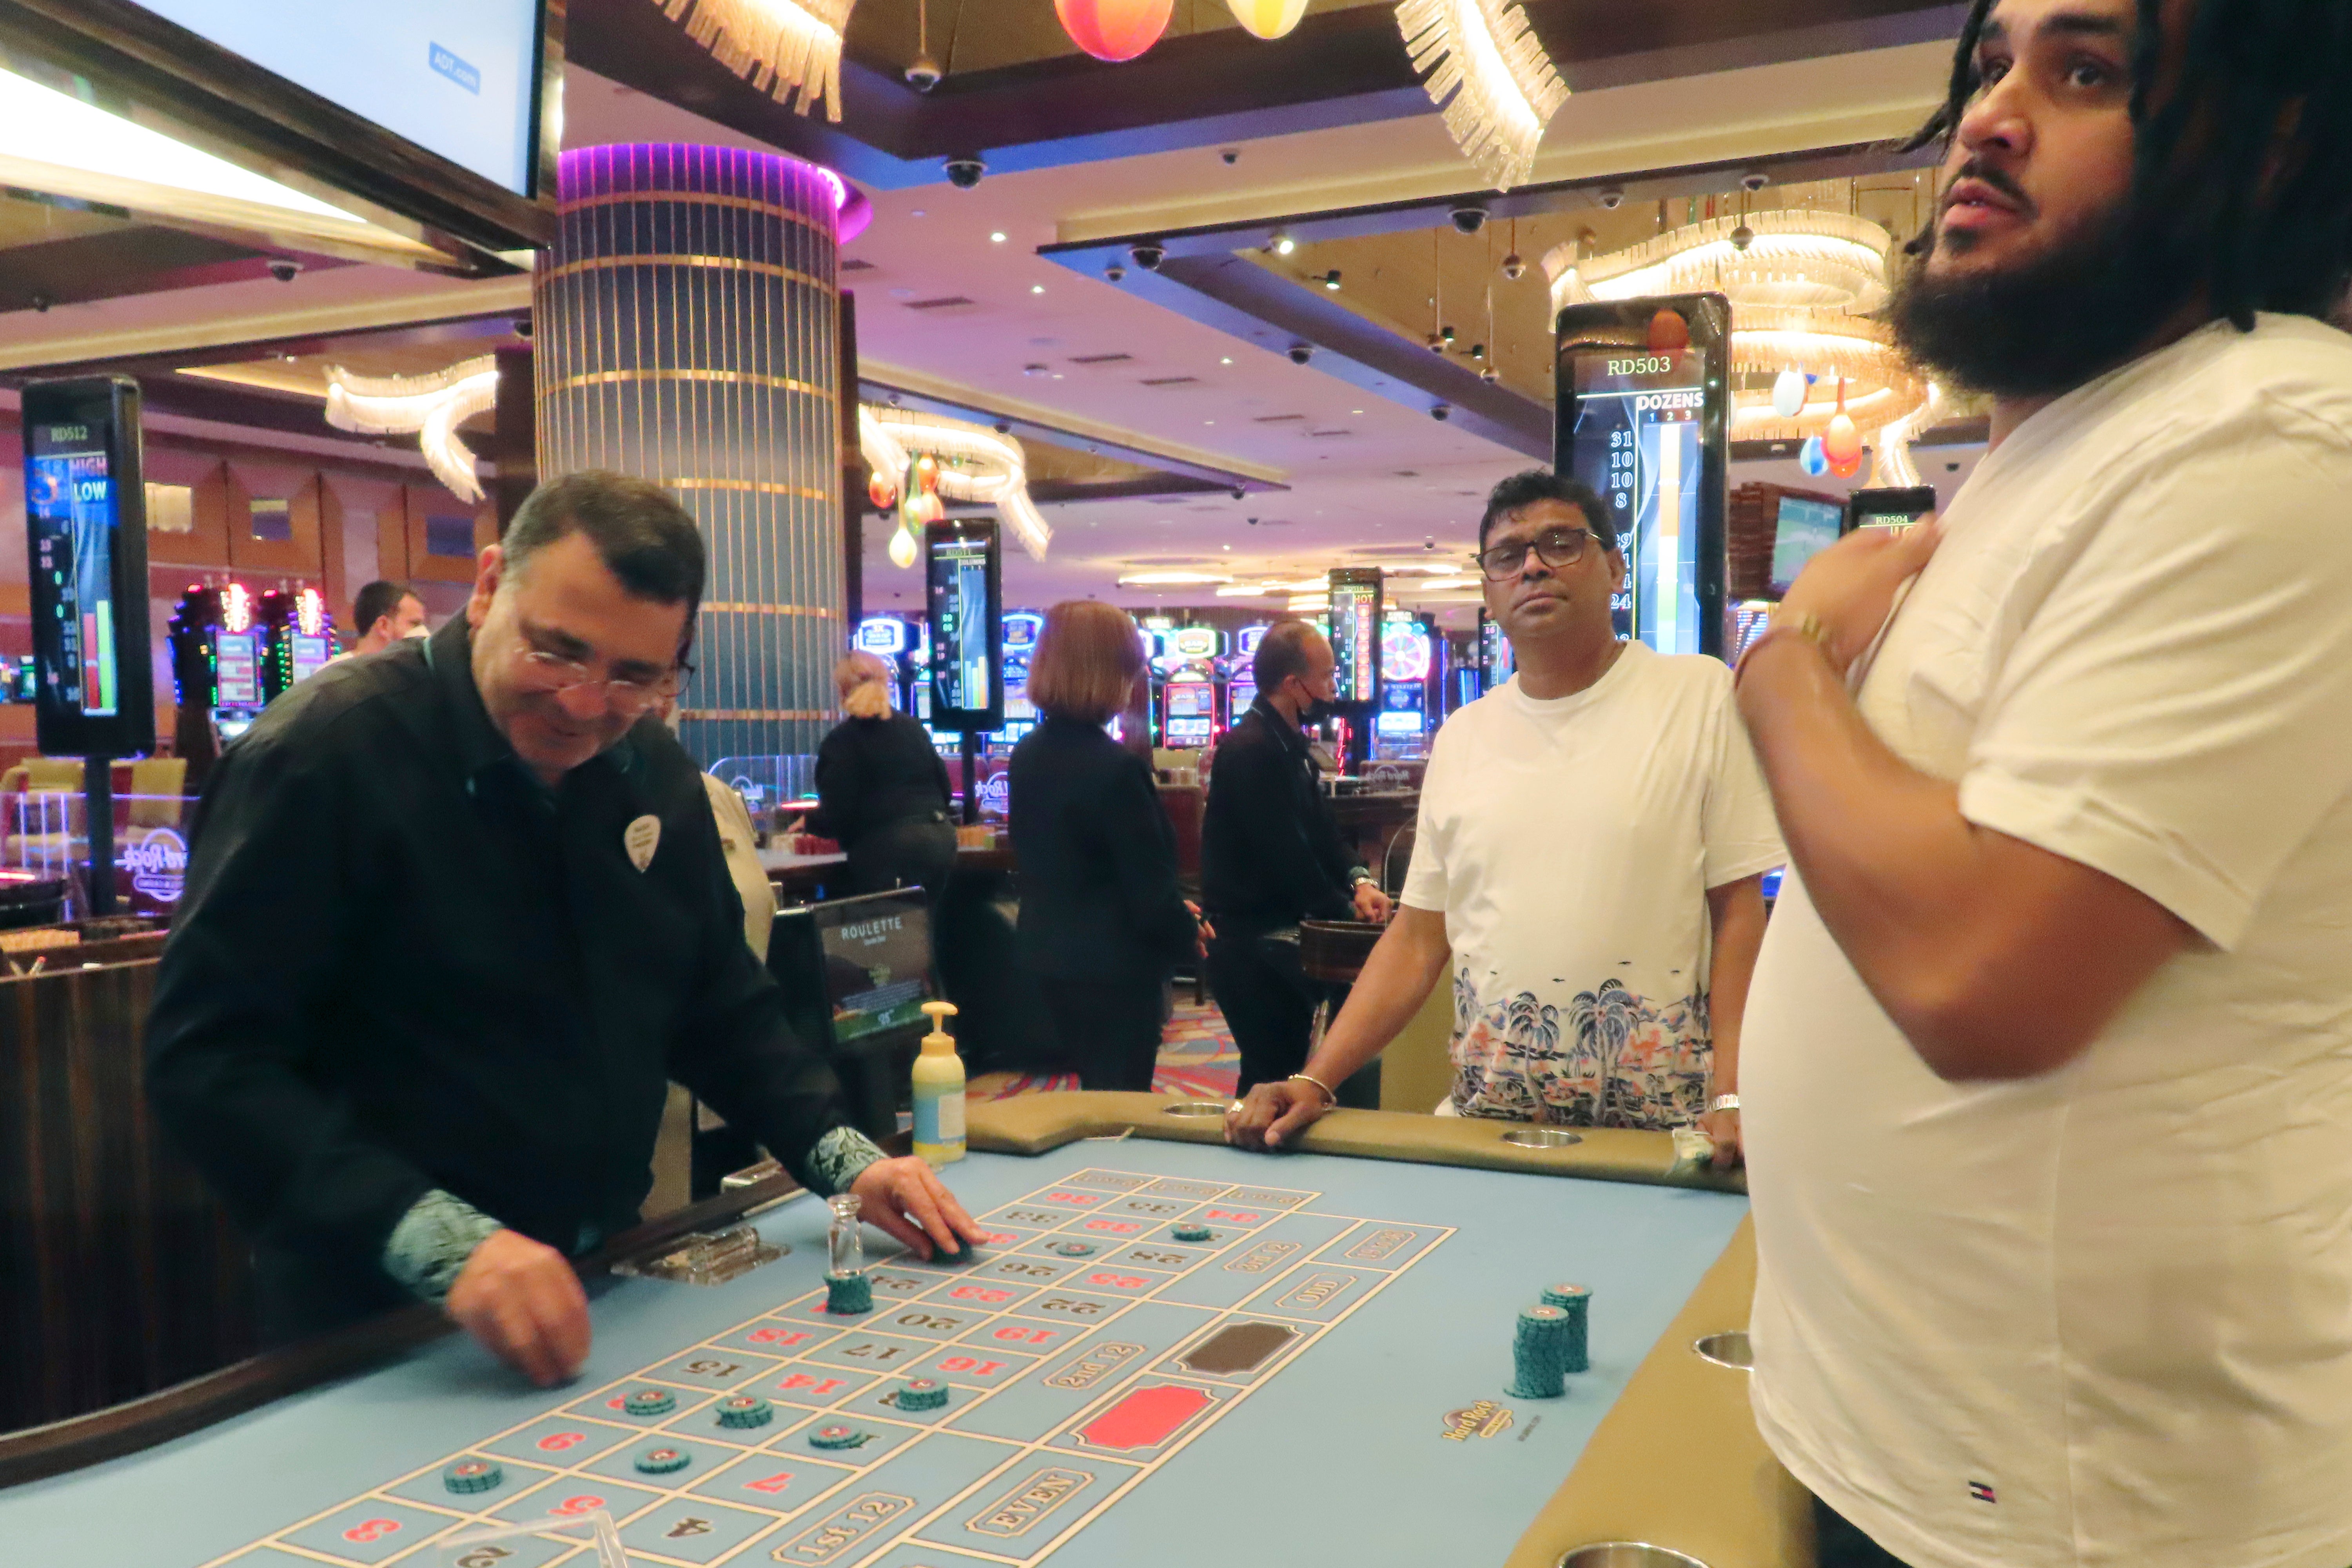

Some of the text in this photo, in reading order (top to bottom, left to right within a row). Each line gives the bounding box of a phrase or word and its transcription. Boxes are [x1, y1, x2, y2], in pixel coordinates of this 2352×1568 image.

[1607, 356, 1671, 376] RD503
[1638, 392, 1704, 411] DOZENS
[1650, 410, 1692, 422] 1 2 3
[1611, 430, 1632, 447] 31
[1612, 451, 1633, 468] 10
[1611, 472, 1633, 488] 10
[73, 481, 107, 502] LOW
[1615, 492, 1627, 508] 8
[1876, 515, 1908, 524] RD504
[1354, 594, 1374, 604] HOT
[1610, 593, 1632, 609] 24
[842, 916, 902, 940] ROULETTE
[1205, 1209, 1261, 1223] 34
[998, 1262, 1058, 1276] 26
[1083, 1273, 1152, 1289] 25
[948, 1285, 1018, 1303] 23
[1295, 1281, 1339, 1302] ODD
[1041, 1299, 1107, 1314] 22
[896, 1314, 964, 1329] 20
[747, 1328, 814, 1346] 18
[993, 1327, 1060, 1344] 19
[840, 1344, 906, 1360] 17
[681, 1360, 742, 1377] 15
[936, 1356, 1009, 1376] 16
[1058, 1345, 1134, 1387] 2nd 12
[776, 1373, 849, 1395] 14
[1441, 1418, 1477, 1442] Hard
[1461, 1400, 1502, 1421] Rock
[742, 1472, 795, 1493] 7
[986, 1474, 1076, 1529] EVEN
[342, 1518, 402, 1542] 3
[666, 1516, 711, 1537] 4
[795, 1500, 896, 1557] 1st 12
